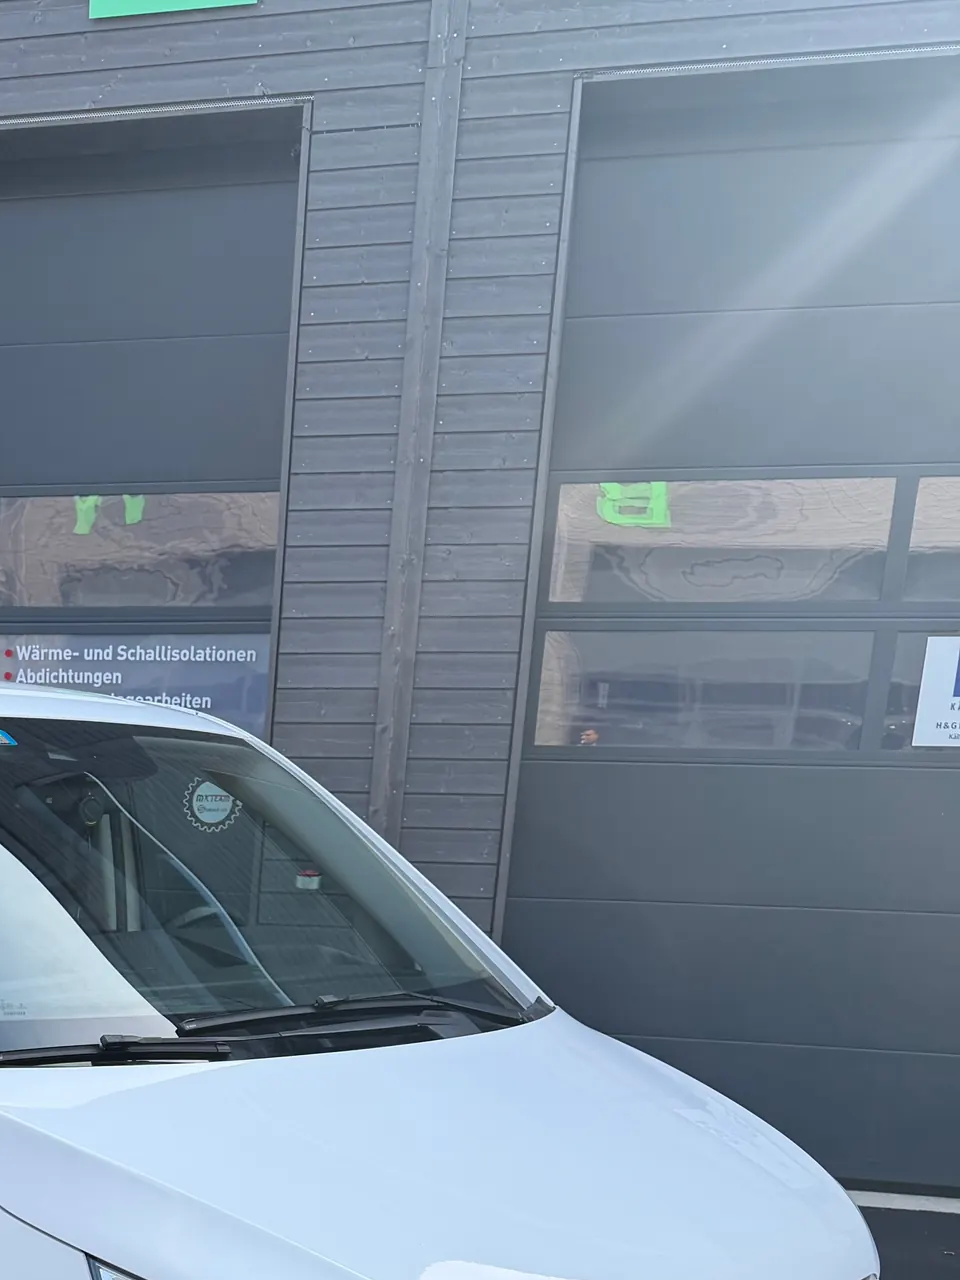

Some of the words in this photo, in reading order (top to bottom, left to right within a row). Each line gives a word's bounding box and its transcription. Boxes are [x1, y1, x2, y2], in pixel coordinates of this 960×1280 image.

[16, 645, 79, 661] Wärme-
[84, 645, 113, 661] und
[117, 645, 257, 663] Schallisolationen
[16, 668, 122, 687] Abdichtungen
